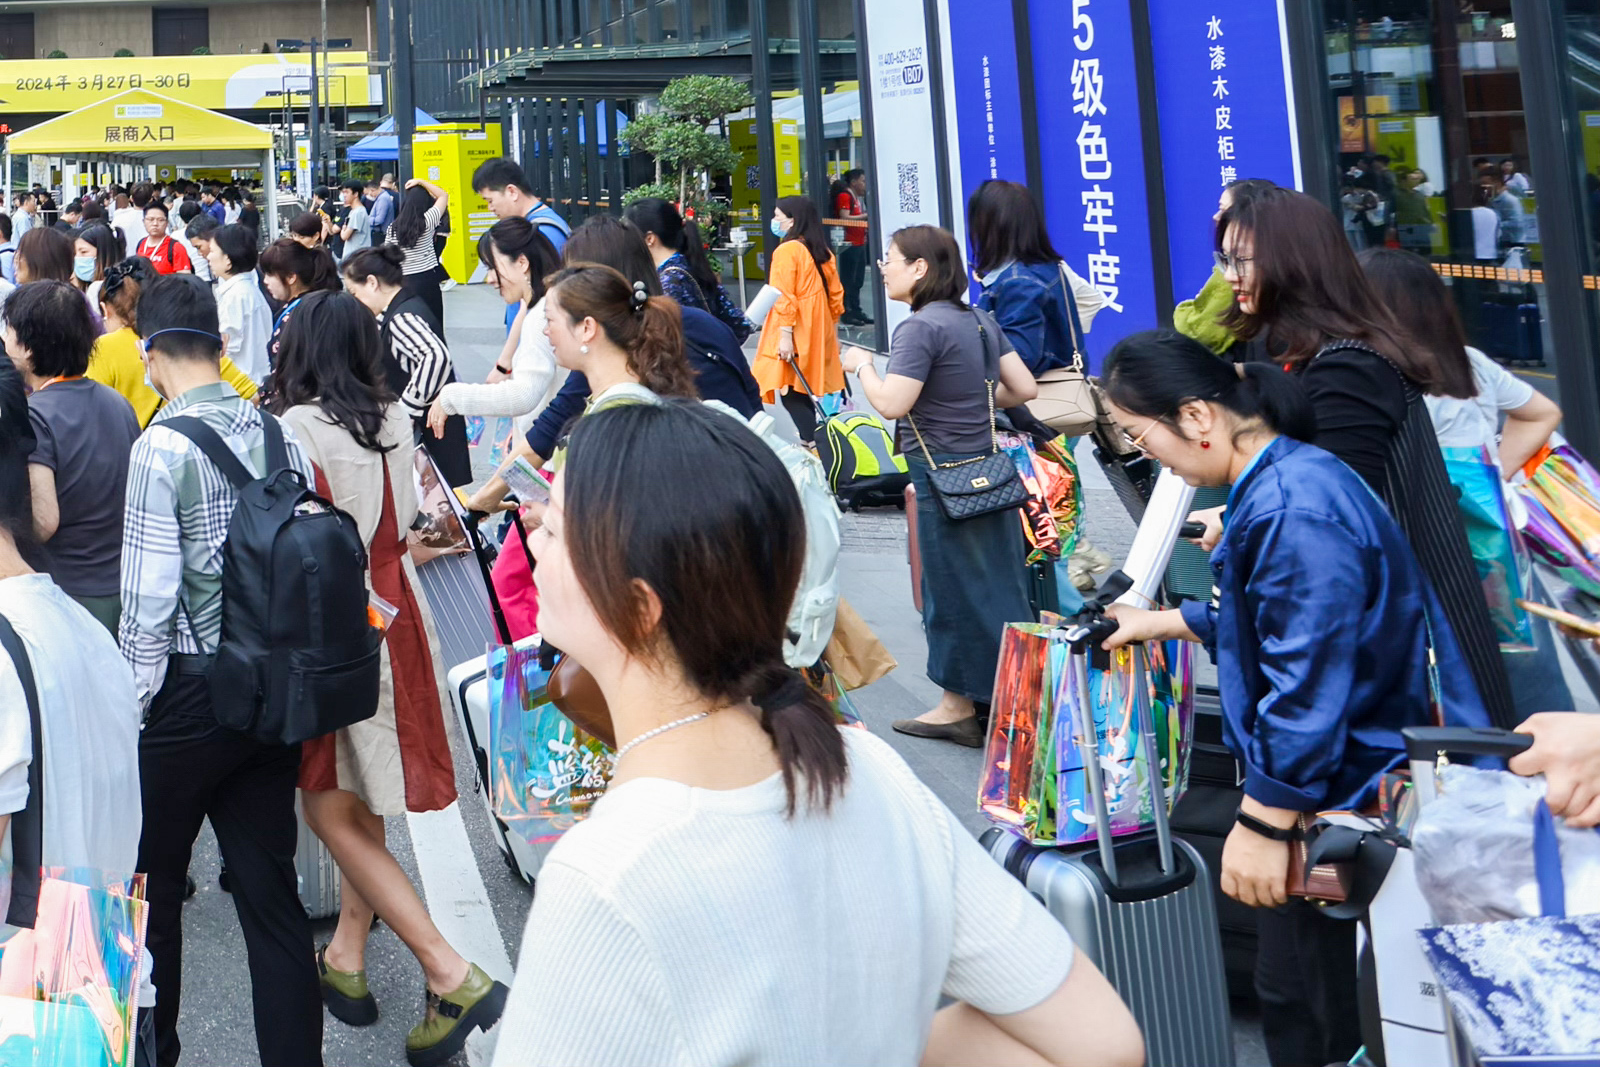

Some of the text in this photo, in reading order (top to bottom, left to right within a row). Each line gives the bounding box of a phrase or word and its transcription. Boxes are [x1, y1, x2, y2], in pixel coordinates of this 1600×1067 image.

[16, 75, 71, 91] 2024年
[903, 65, 922, 84] 1B07
[104, 125, 174, 143] 展商入口
